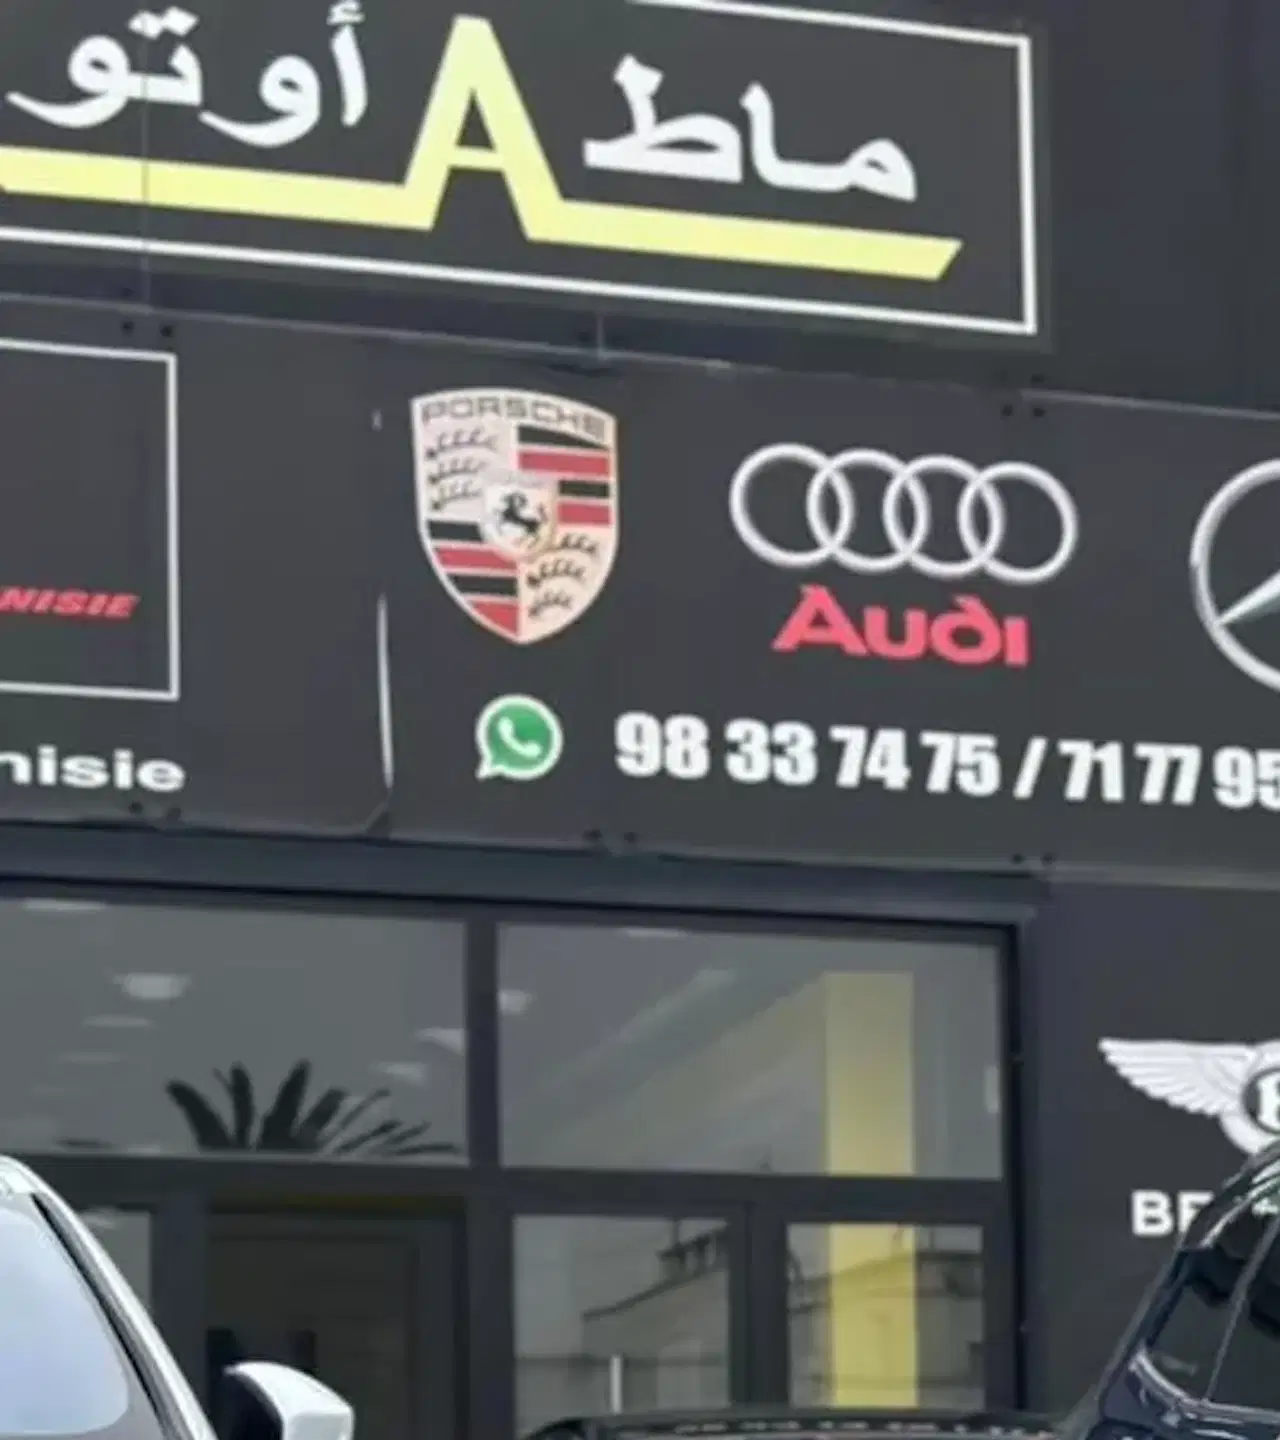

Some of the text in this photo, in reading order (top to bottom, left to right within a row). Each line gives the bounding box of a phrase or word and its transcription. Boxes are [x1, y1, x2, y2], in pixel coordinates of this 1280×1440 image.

[5, 0, 368, 148] أوتو
[584, 54, 917, 202] ماط
[421, 396, 607, 442] PORSCHE
[771, 584, 1029, 668] Audi
[614, 711, 710, 780] 98
[724, 718, 818, 787] 33
[829, 725, 911, 791] 74
[919, 731, 1002, 798] 75
[1057, 739, 1125, 803] 71
[1133, 742, 1203, 807] 77
